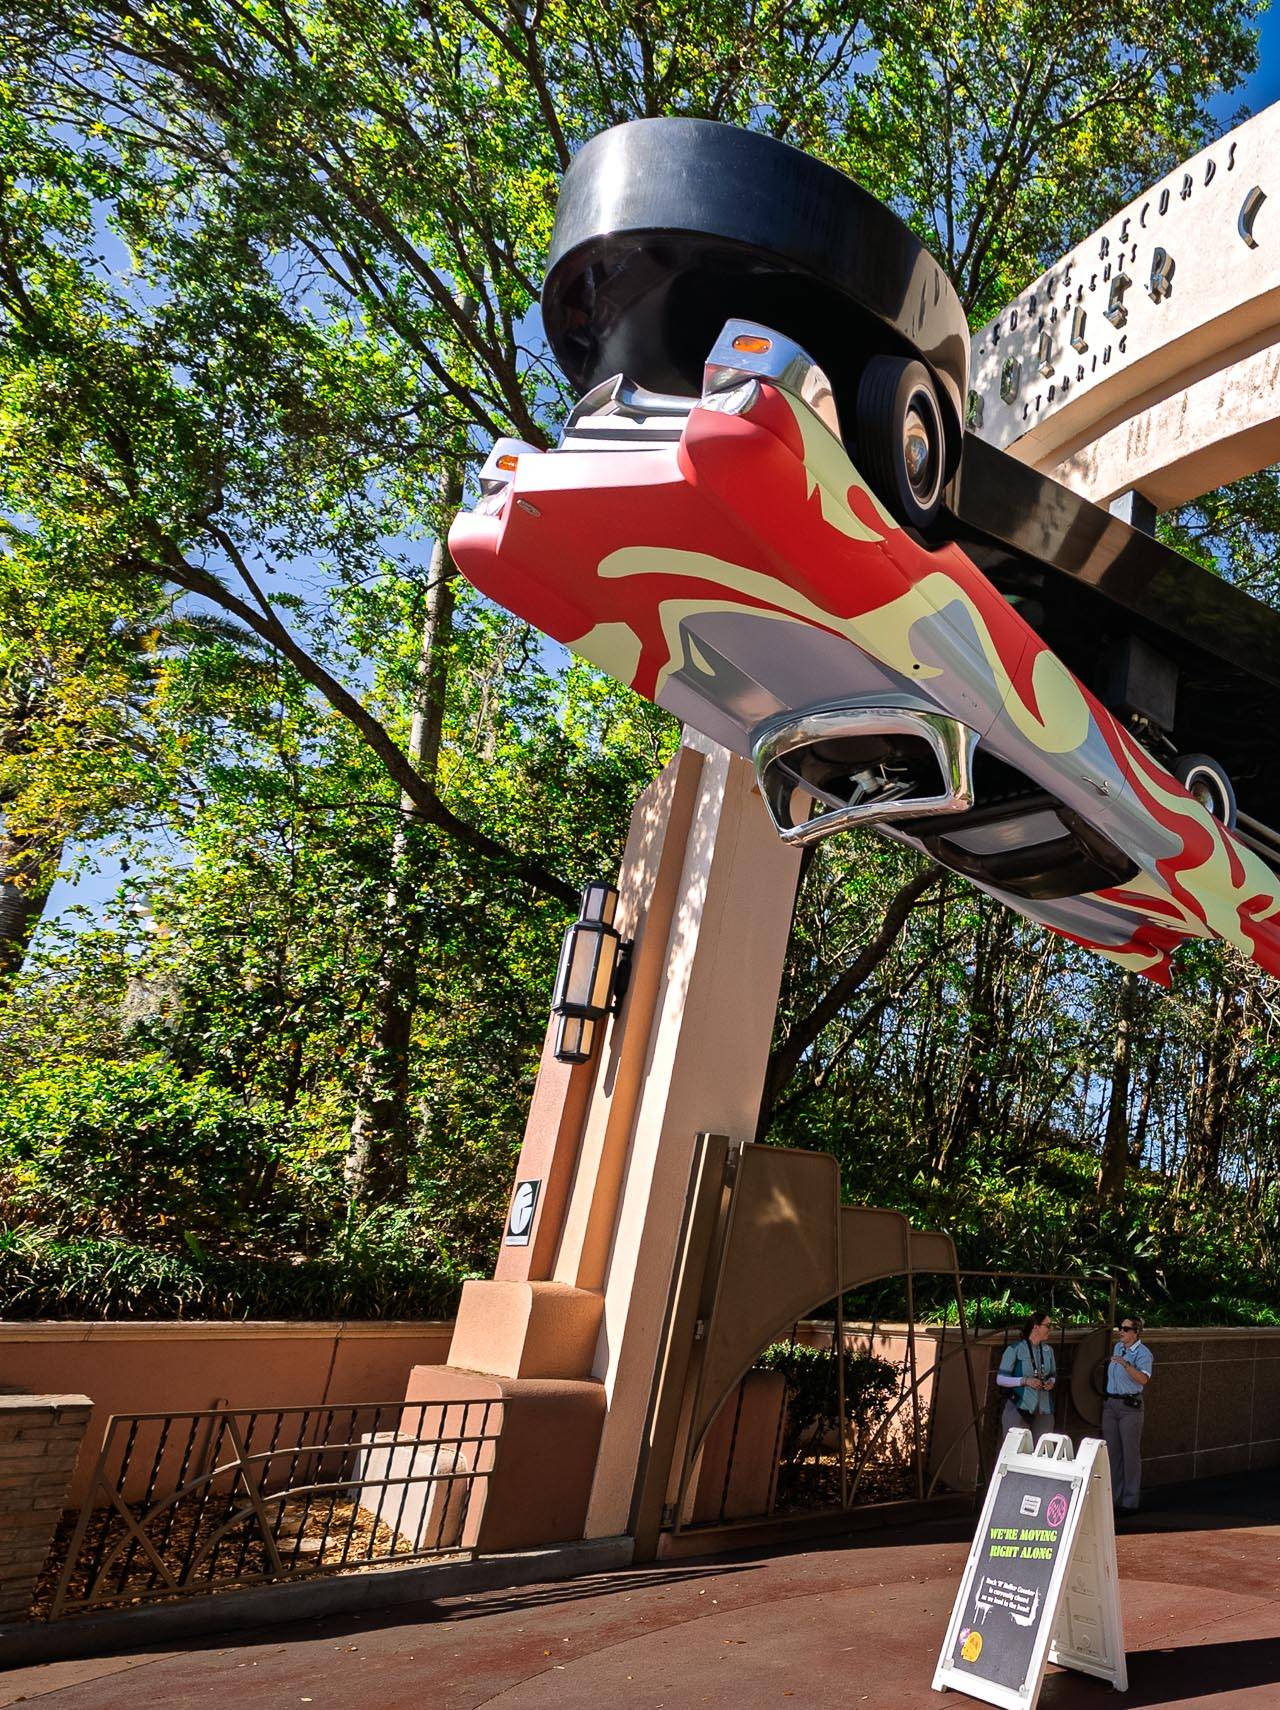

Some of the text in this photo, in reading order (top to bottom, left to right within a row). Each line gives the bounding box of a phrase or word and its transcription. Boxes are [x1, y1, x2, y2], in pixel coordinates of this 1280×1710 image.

[1099, 142, 1237, 261] RECORDS
[1038, 243, 1138, 334] PRESENTS
[1022, 334, 1128, 421] STARRING
[989, 1545, 1053, 1560] RIGHT ALONG
[990, 1528, 1058, 1542] WE'RE MOVING
